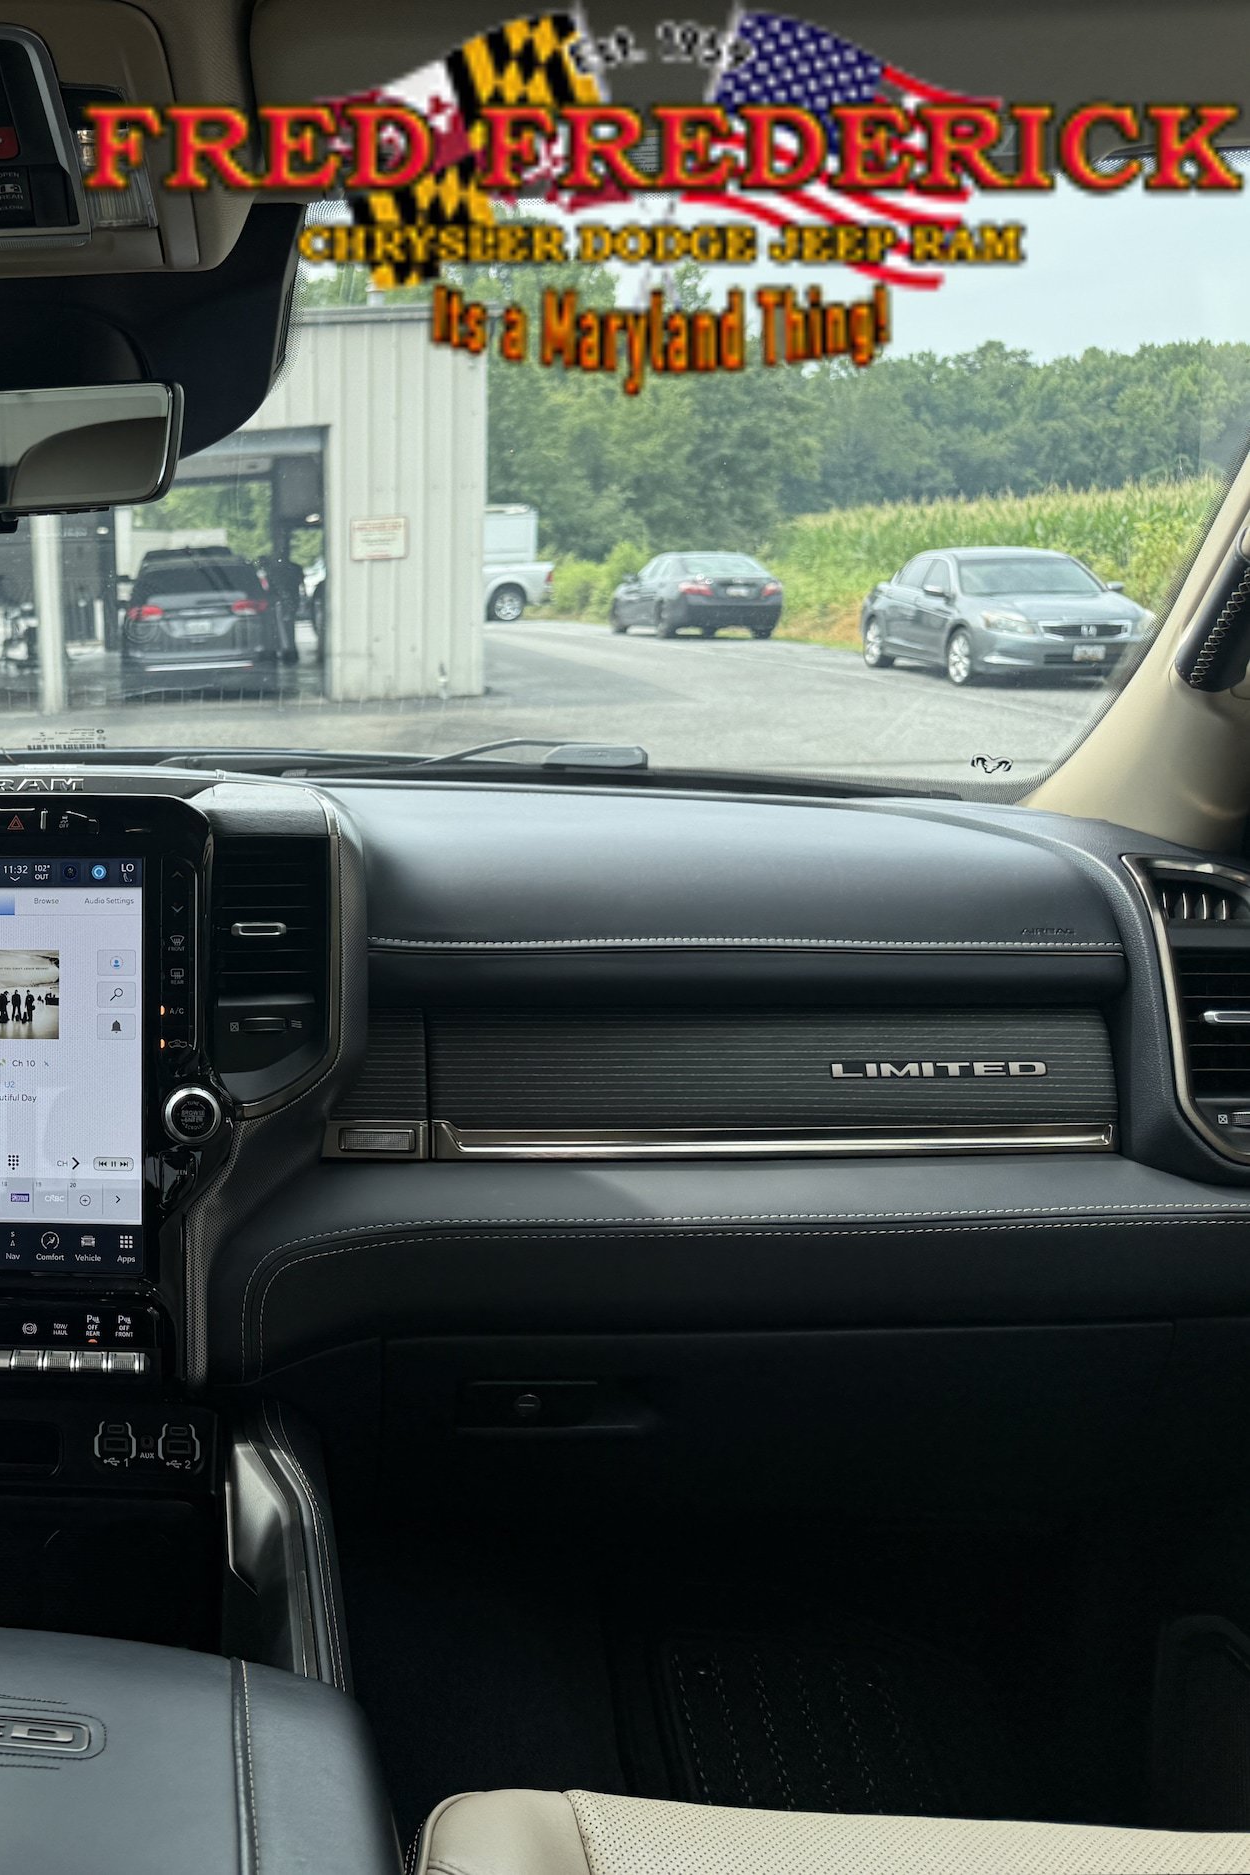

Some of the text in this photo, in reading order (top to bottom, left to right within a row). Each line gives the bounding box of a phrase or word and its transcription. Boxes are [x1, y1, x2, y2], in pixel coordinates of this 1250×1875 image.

[3, 865, 29, 874] 11:32
[121, 863, 135, 872] LO
[34, 897, 59, 905] Browse
[84, 897, 135, 906] Audio Settings
[169, 1007, 185, 1015] A/C
[12, 1059, 24, 1067] Ch
[26, 1059, 36, 1067] 10
[831, 1061, 1047, 1078] LIMITED
[21, 1093, 37, 1103] Day
[56, 1159, 68, 1167] CH
[5, 1252, 20, 1260] Nav
[35, 1253, 65, 1261] Comfort
[75, 1254, 101, 1262] Vehicle
[117, 1255, 136, 1264] Apps
[123, 1458, 129, 1468] 1
[184, 1460, 191, 1470] 2
